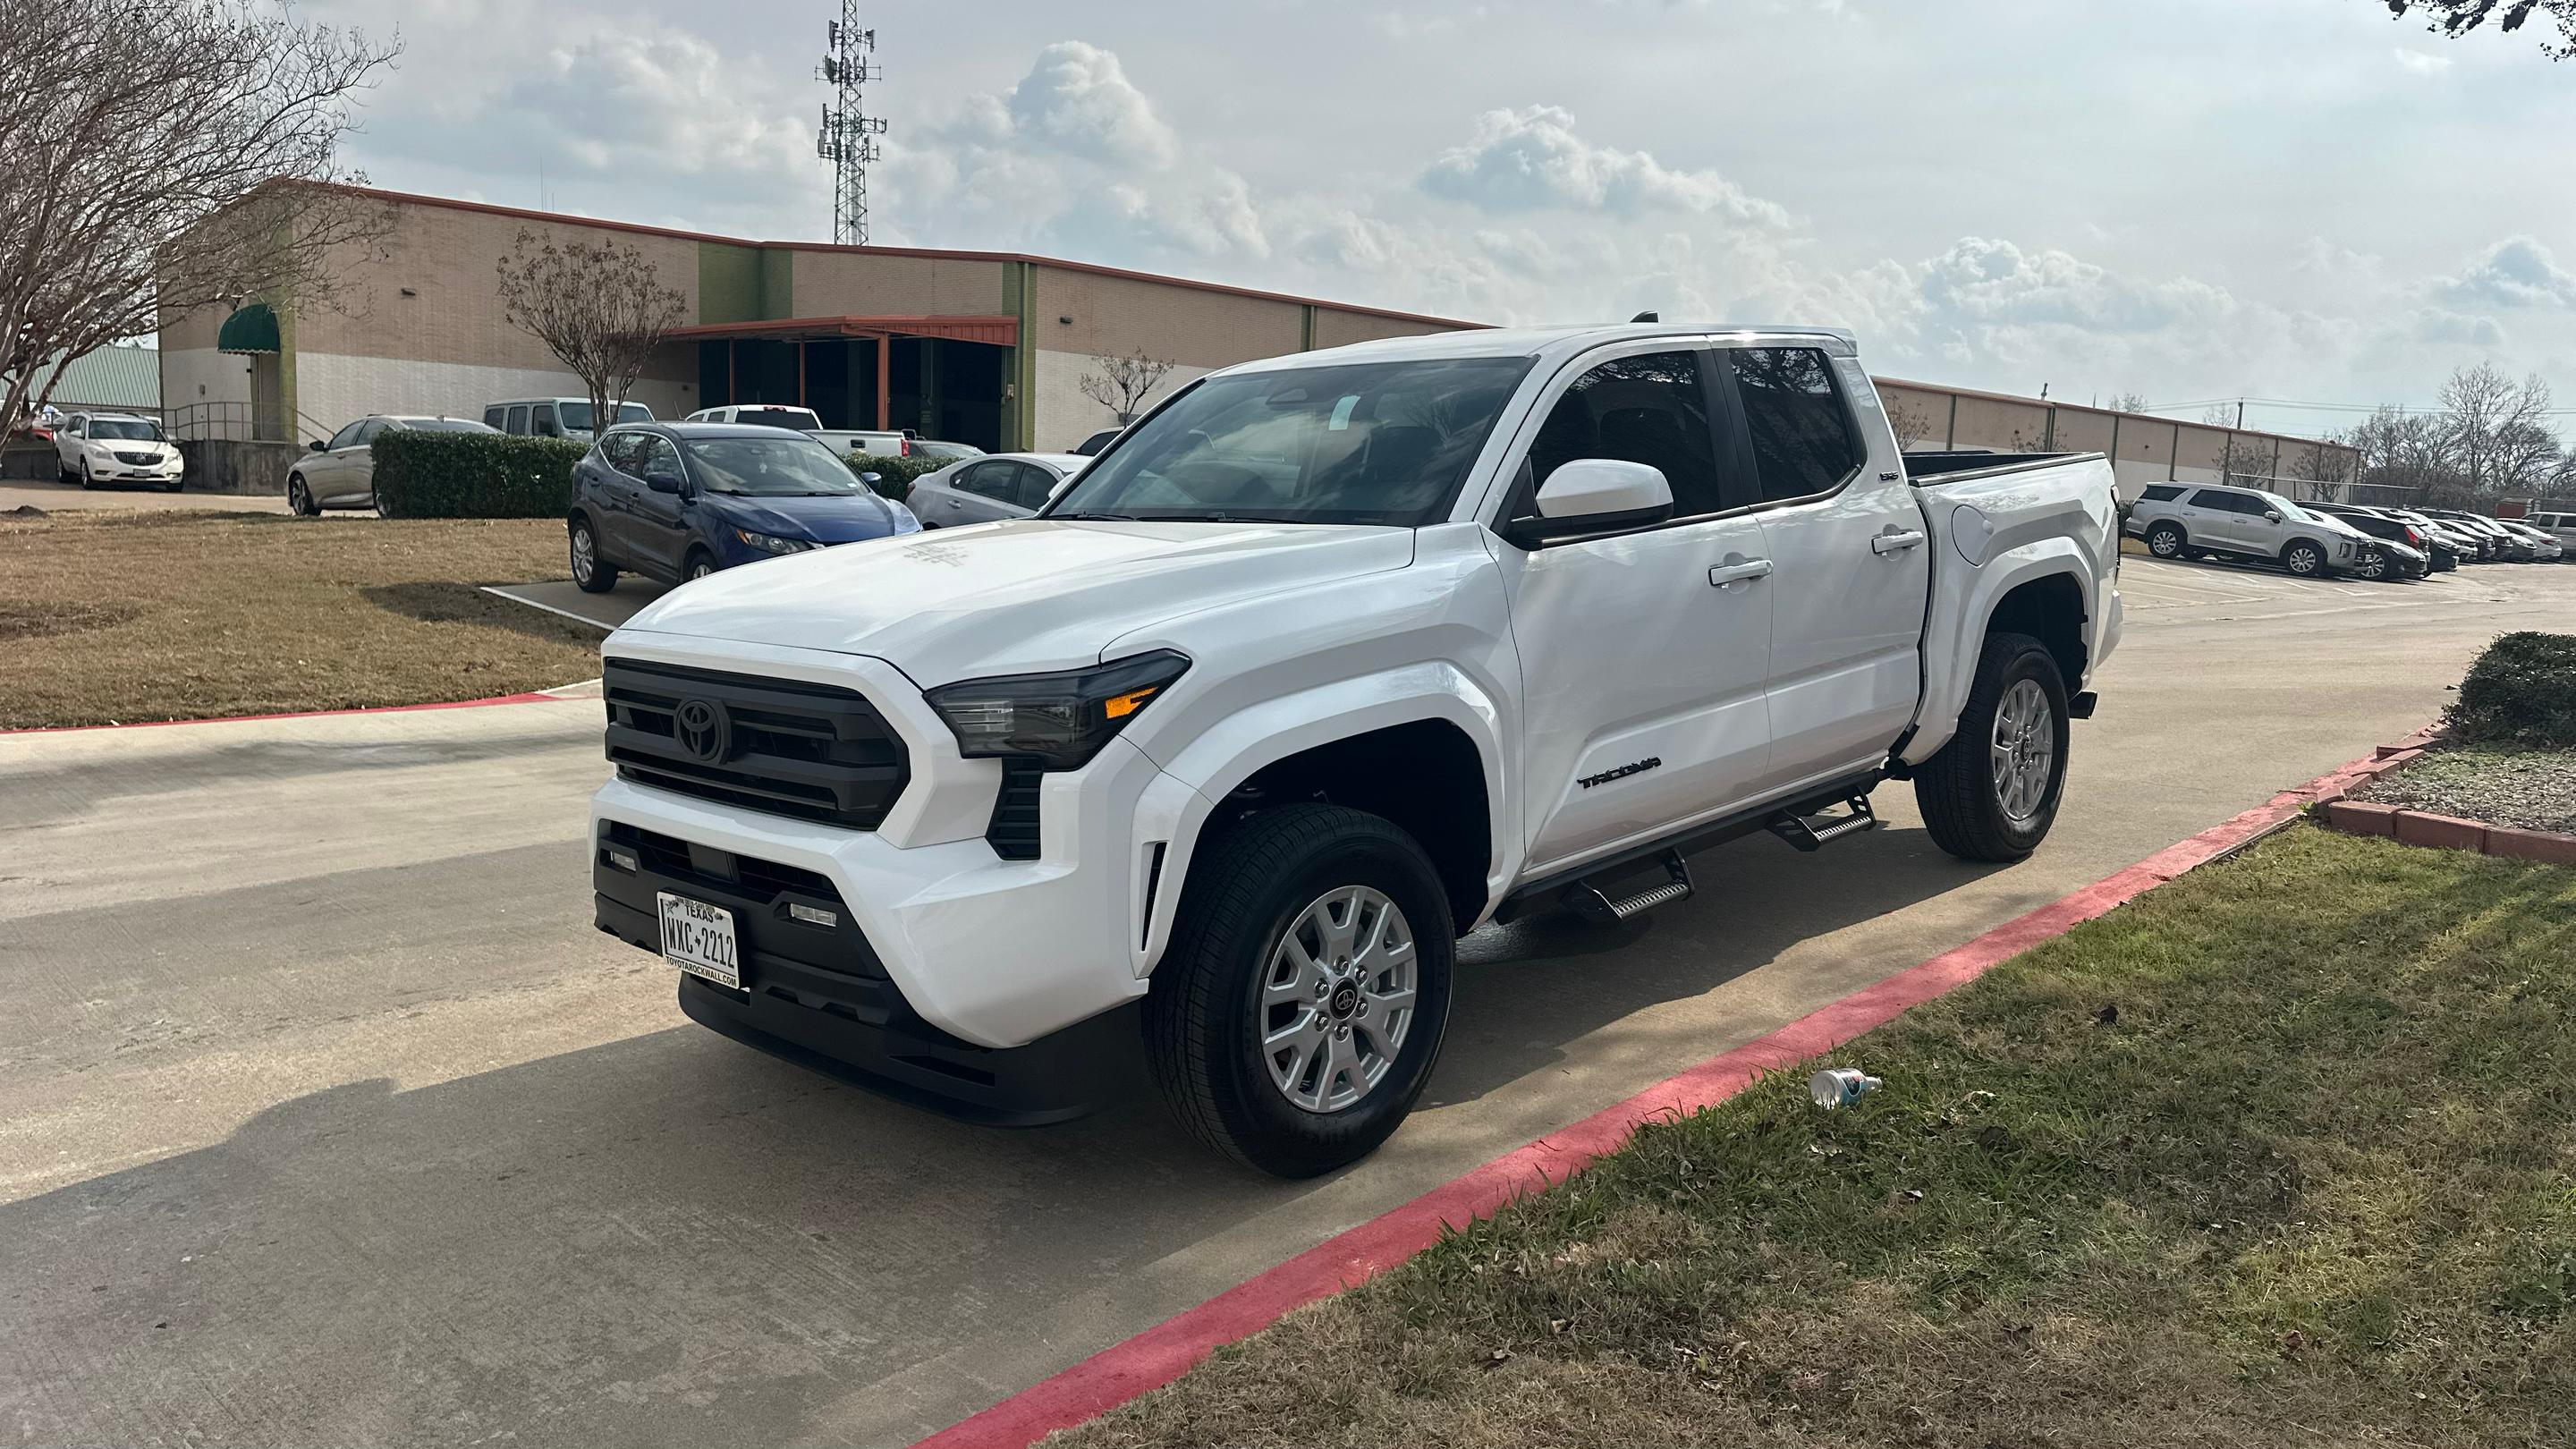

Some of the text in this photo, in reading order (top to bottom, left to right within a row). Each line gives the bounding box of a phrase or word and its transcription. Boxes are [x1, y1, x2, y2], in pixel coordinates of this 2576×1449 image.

[1879, 471, 1899, 481] SR5
[1577, 757, 1661, 789] TACOMA
[685, 905, 714, 923] TEXAS
[701, 927, 734, 969] 2212
[665, 955, 737, 987] TOYOTAROCKWALL.COM
